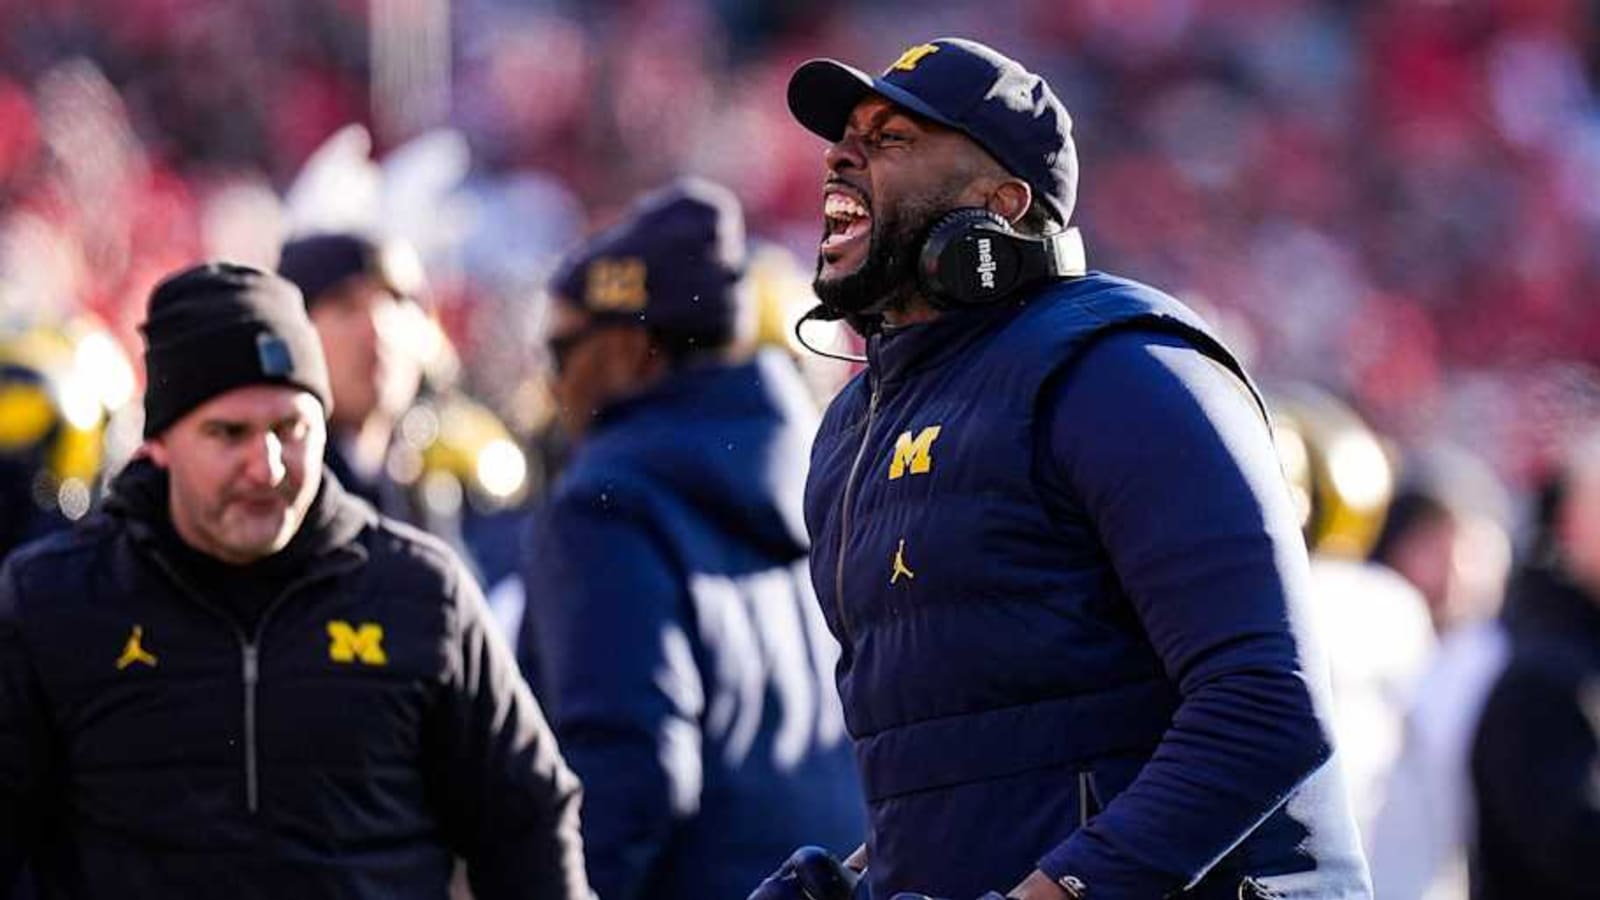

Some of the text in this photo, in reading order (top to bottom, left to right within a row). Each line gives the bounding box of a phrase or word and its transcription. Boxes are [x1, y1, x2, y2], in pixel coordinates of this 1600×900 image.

[977, 238, 997, 289] meijer
[888, 425, 941, 480] M
[327, 620, 387, 665] M
